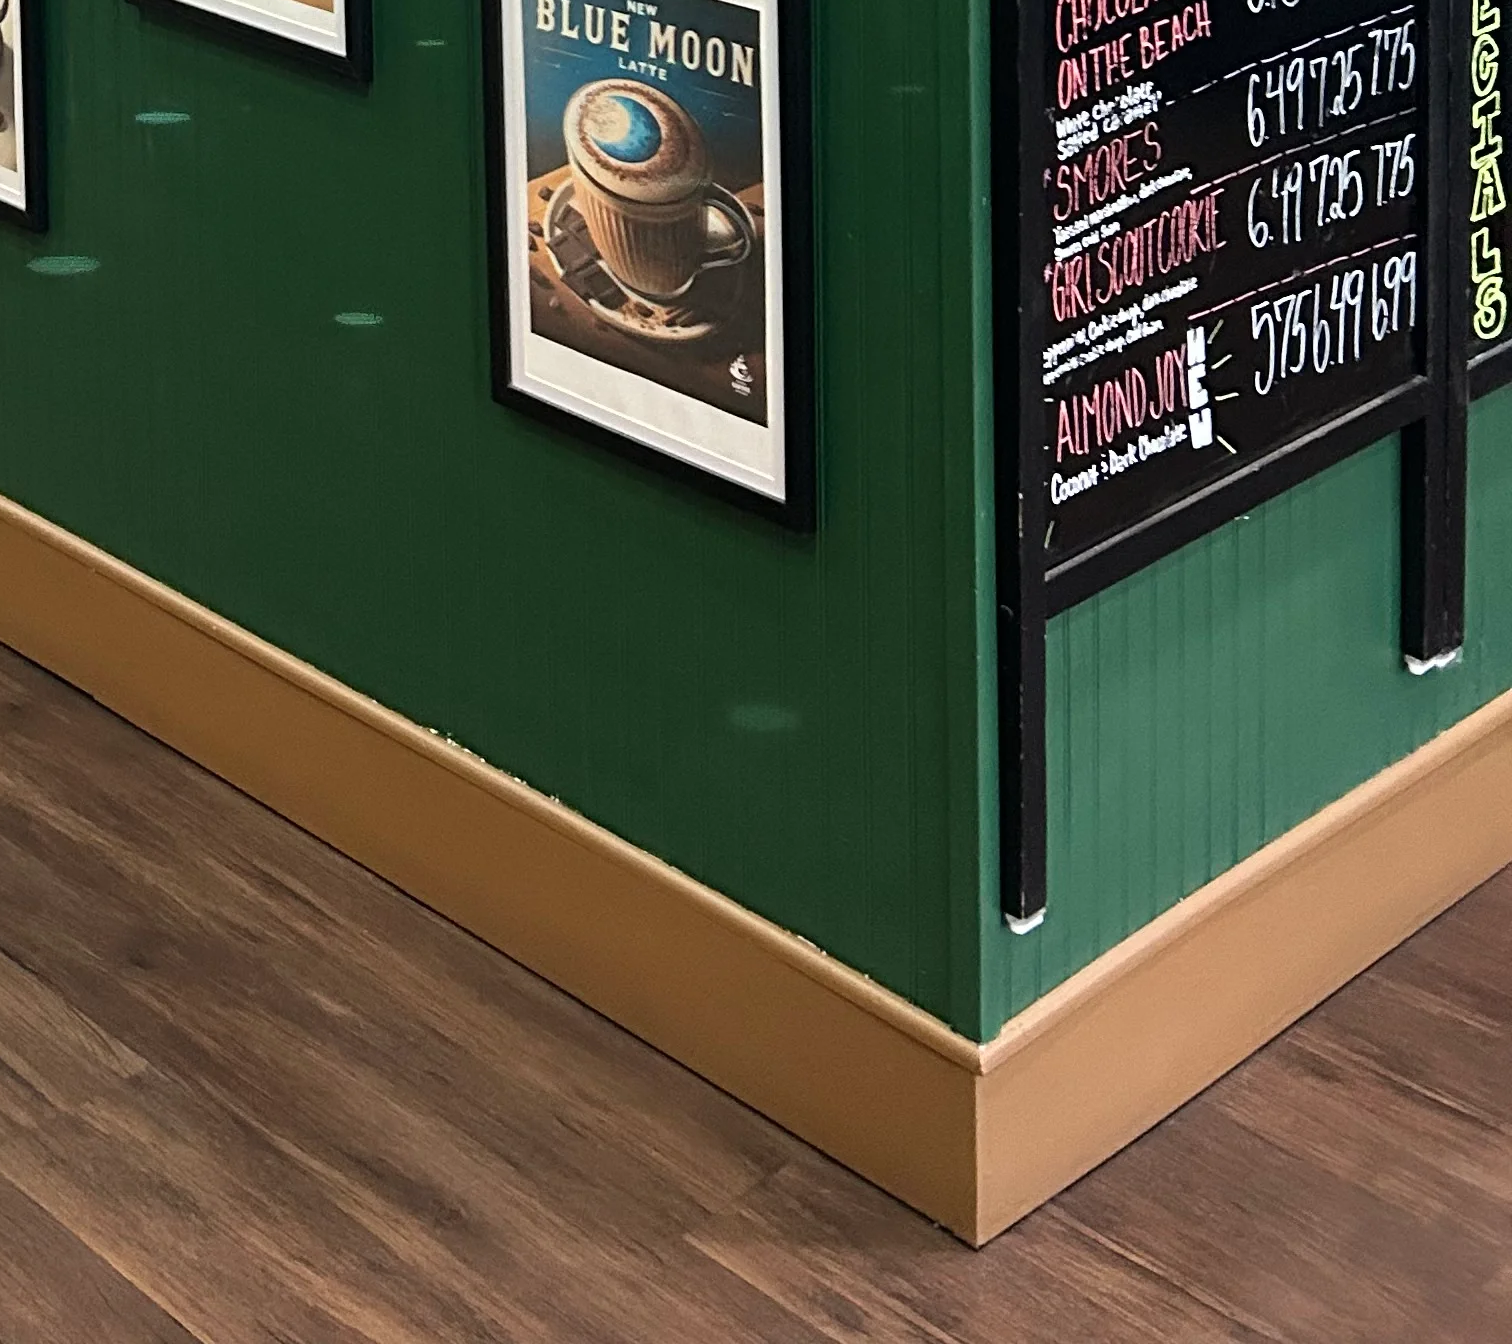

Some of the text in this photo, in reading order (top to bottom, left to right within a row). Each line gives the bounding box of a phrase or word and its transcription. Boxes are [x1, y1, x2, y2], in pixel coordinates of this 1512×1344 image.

[625, 0, 658, 17] NEW
[648, 20, 756, 89] MOON
[1057, 0, 1213, 110] ON THE BEACH
[617, 56, 669, 82] LATTE
[1053, 121, 1163, 221] SMORES
[1246, 57, 1303, 148] 6.49
[1310, 44, 1366, 128] 7.25
[1052, 252, 1096, 323] GIRL
[1095, 218, 1158, 304] SCOUT
[1157, 188, 1228, 274] COOKIE
[1246, 162, 1303, 248] 6.49
[1310, 150, 1366, 228] 7.25
[1370, 133, 1417, 208] 7.75
[1056, 367, 1147, 464] ALMOND
[1149, 343, 1188, 420] JOY
[1250, 289, 1311, 396] 5.75
[1311, 269, 1365, 374] 6.49
[1372, 251, 1418, 343] 6.99
